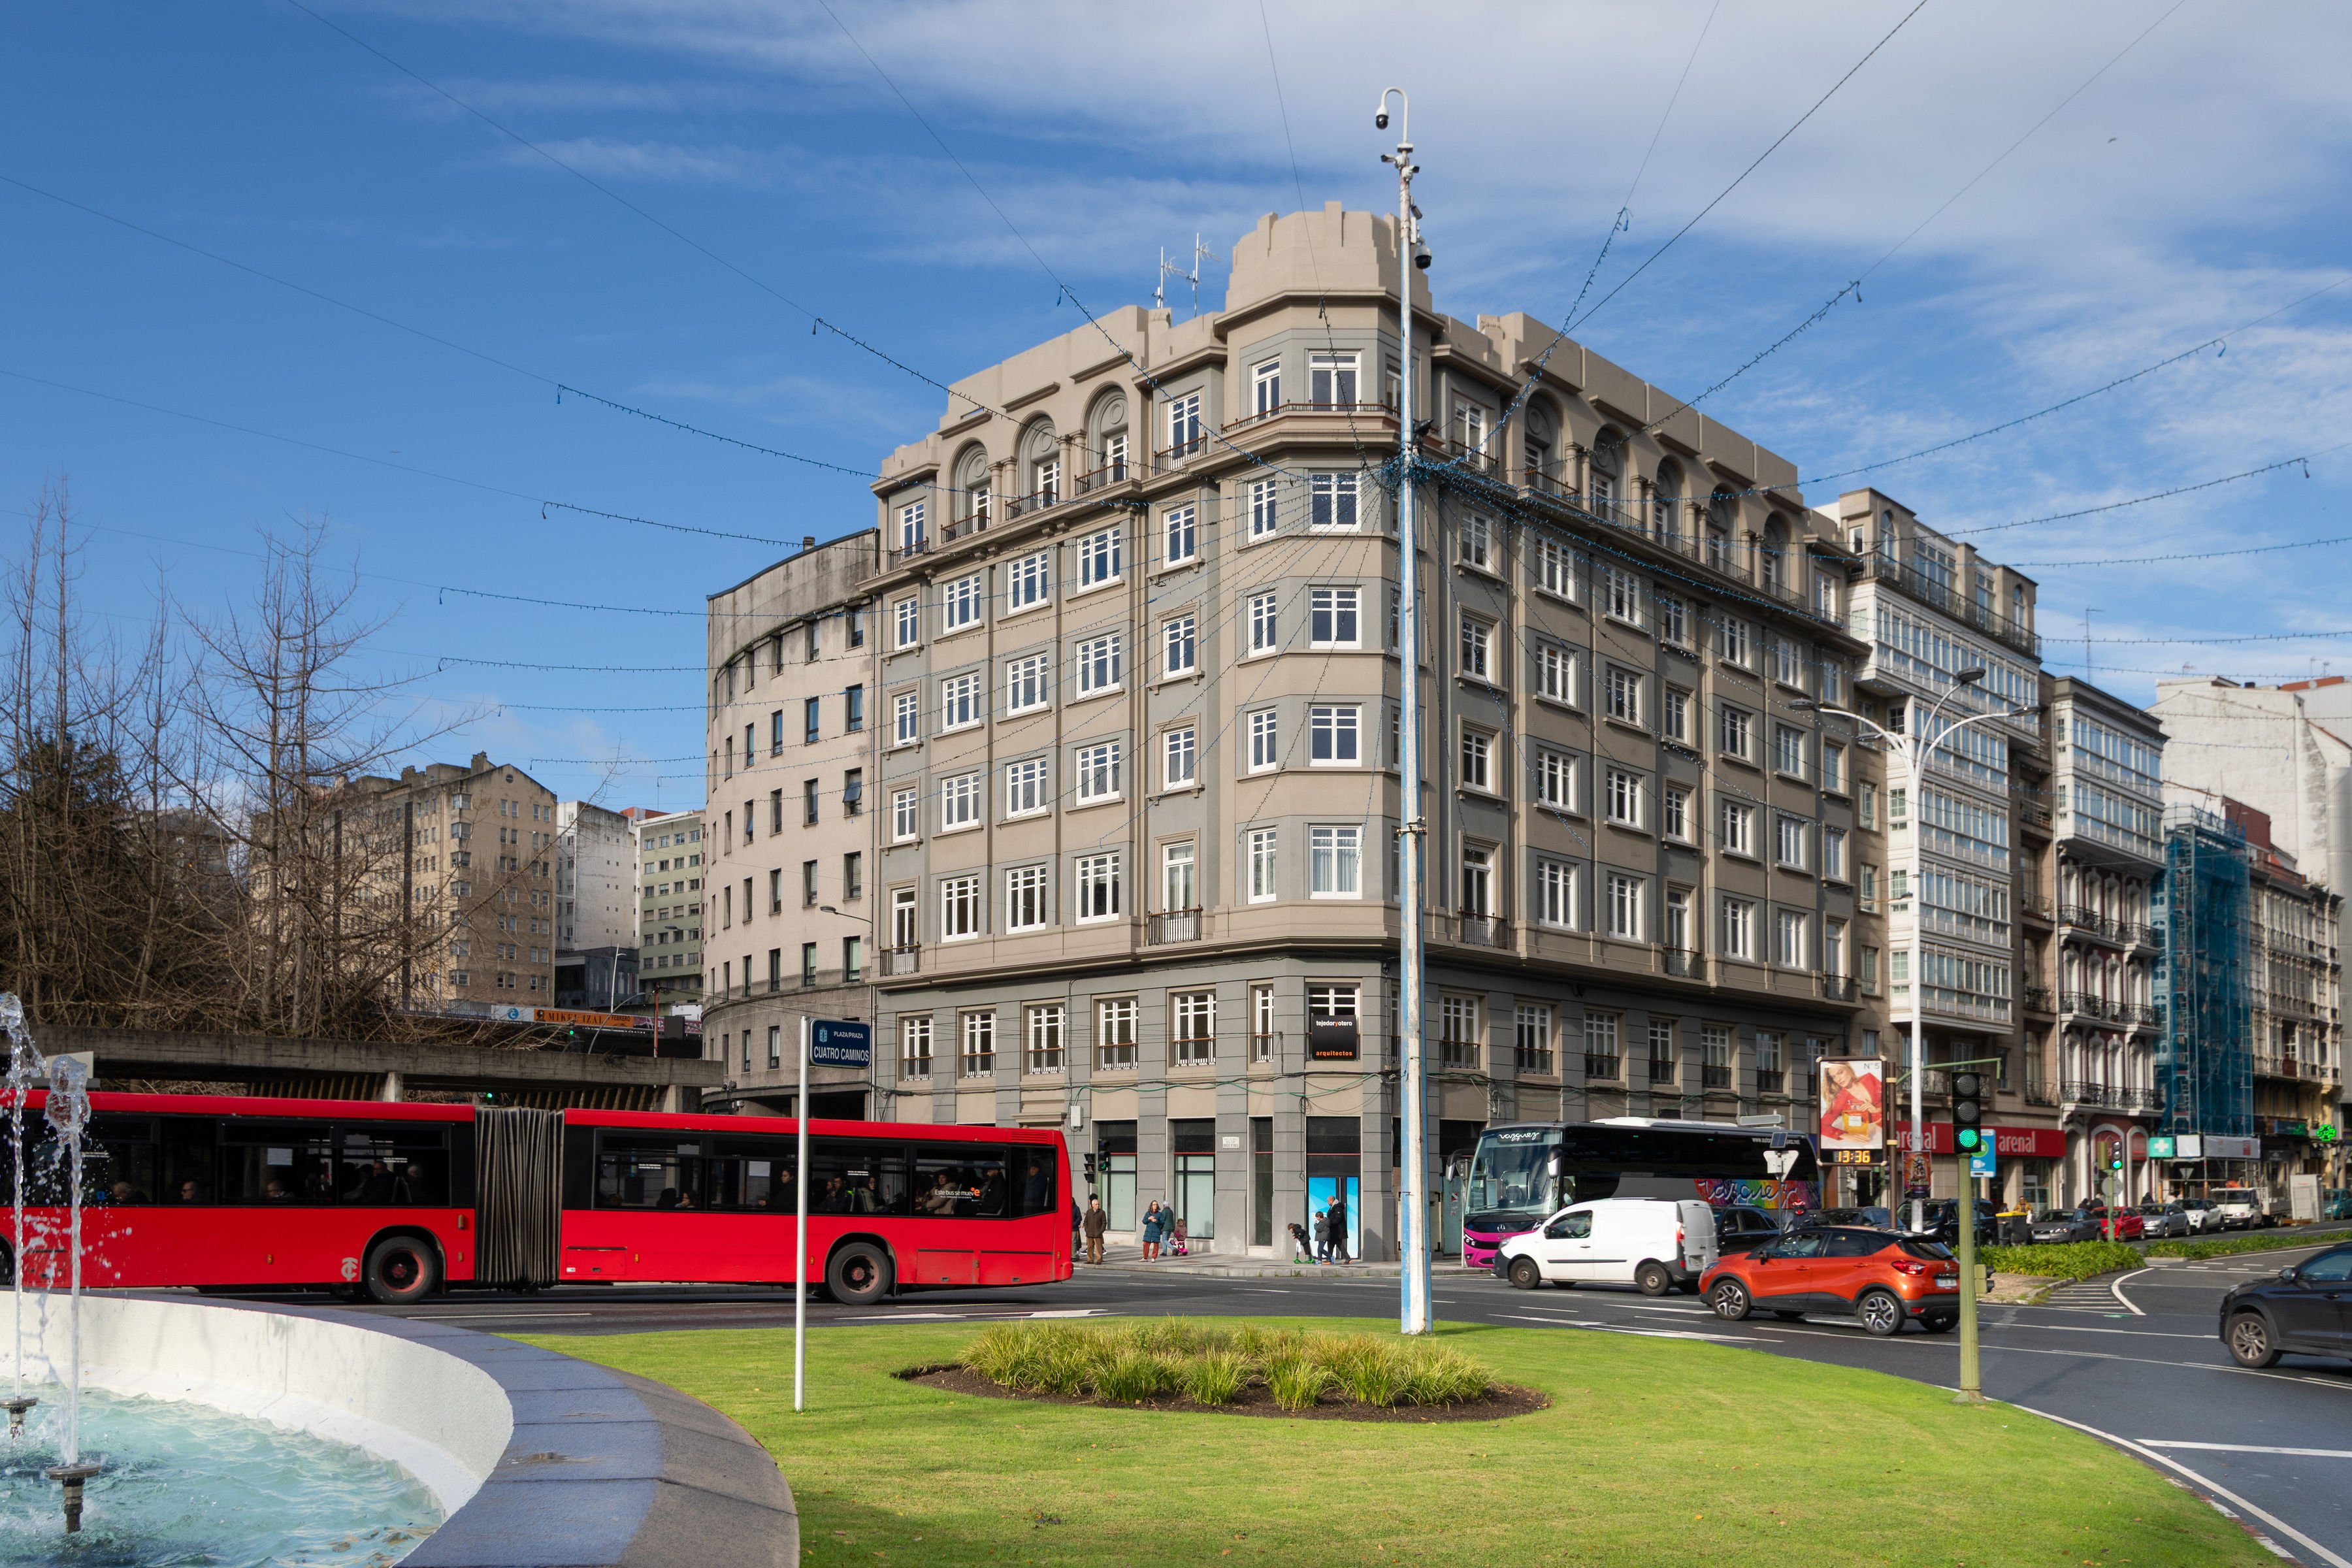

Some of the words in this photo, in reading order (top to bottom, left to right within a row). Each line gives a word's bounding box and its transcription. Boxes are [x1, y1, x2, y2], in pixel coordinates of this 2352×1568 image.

[813, 1046, 840, 1060] CUATRO
[841, 1048, 869, 1062] CAMINOS
[1896, 1126, 1936, 1149] areal
[1999, 1131, 2036, 1152] arenal
[1838, 1150, 1871, 1163] 13:36
